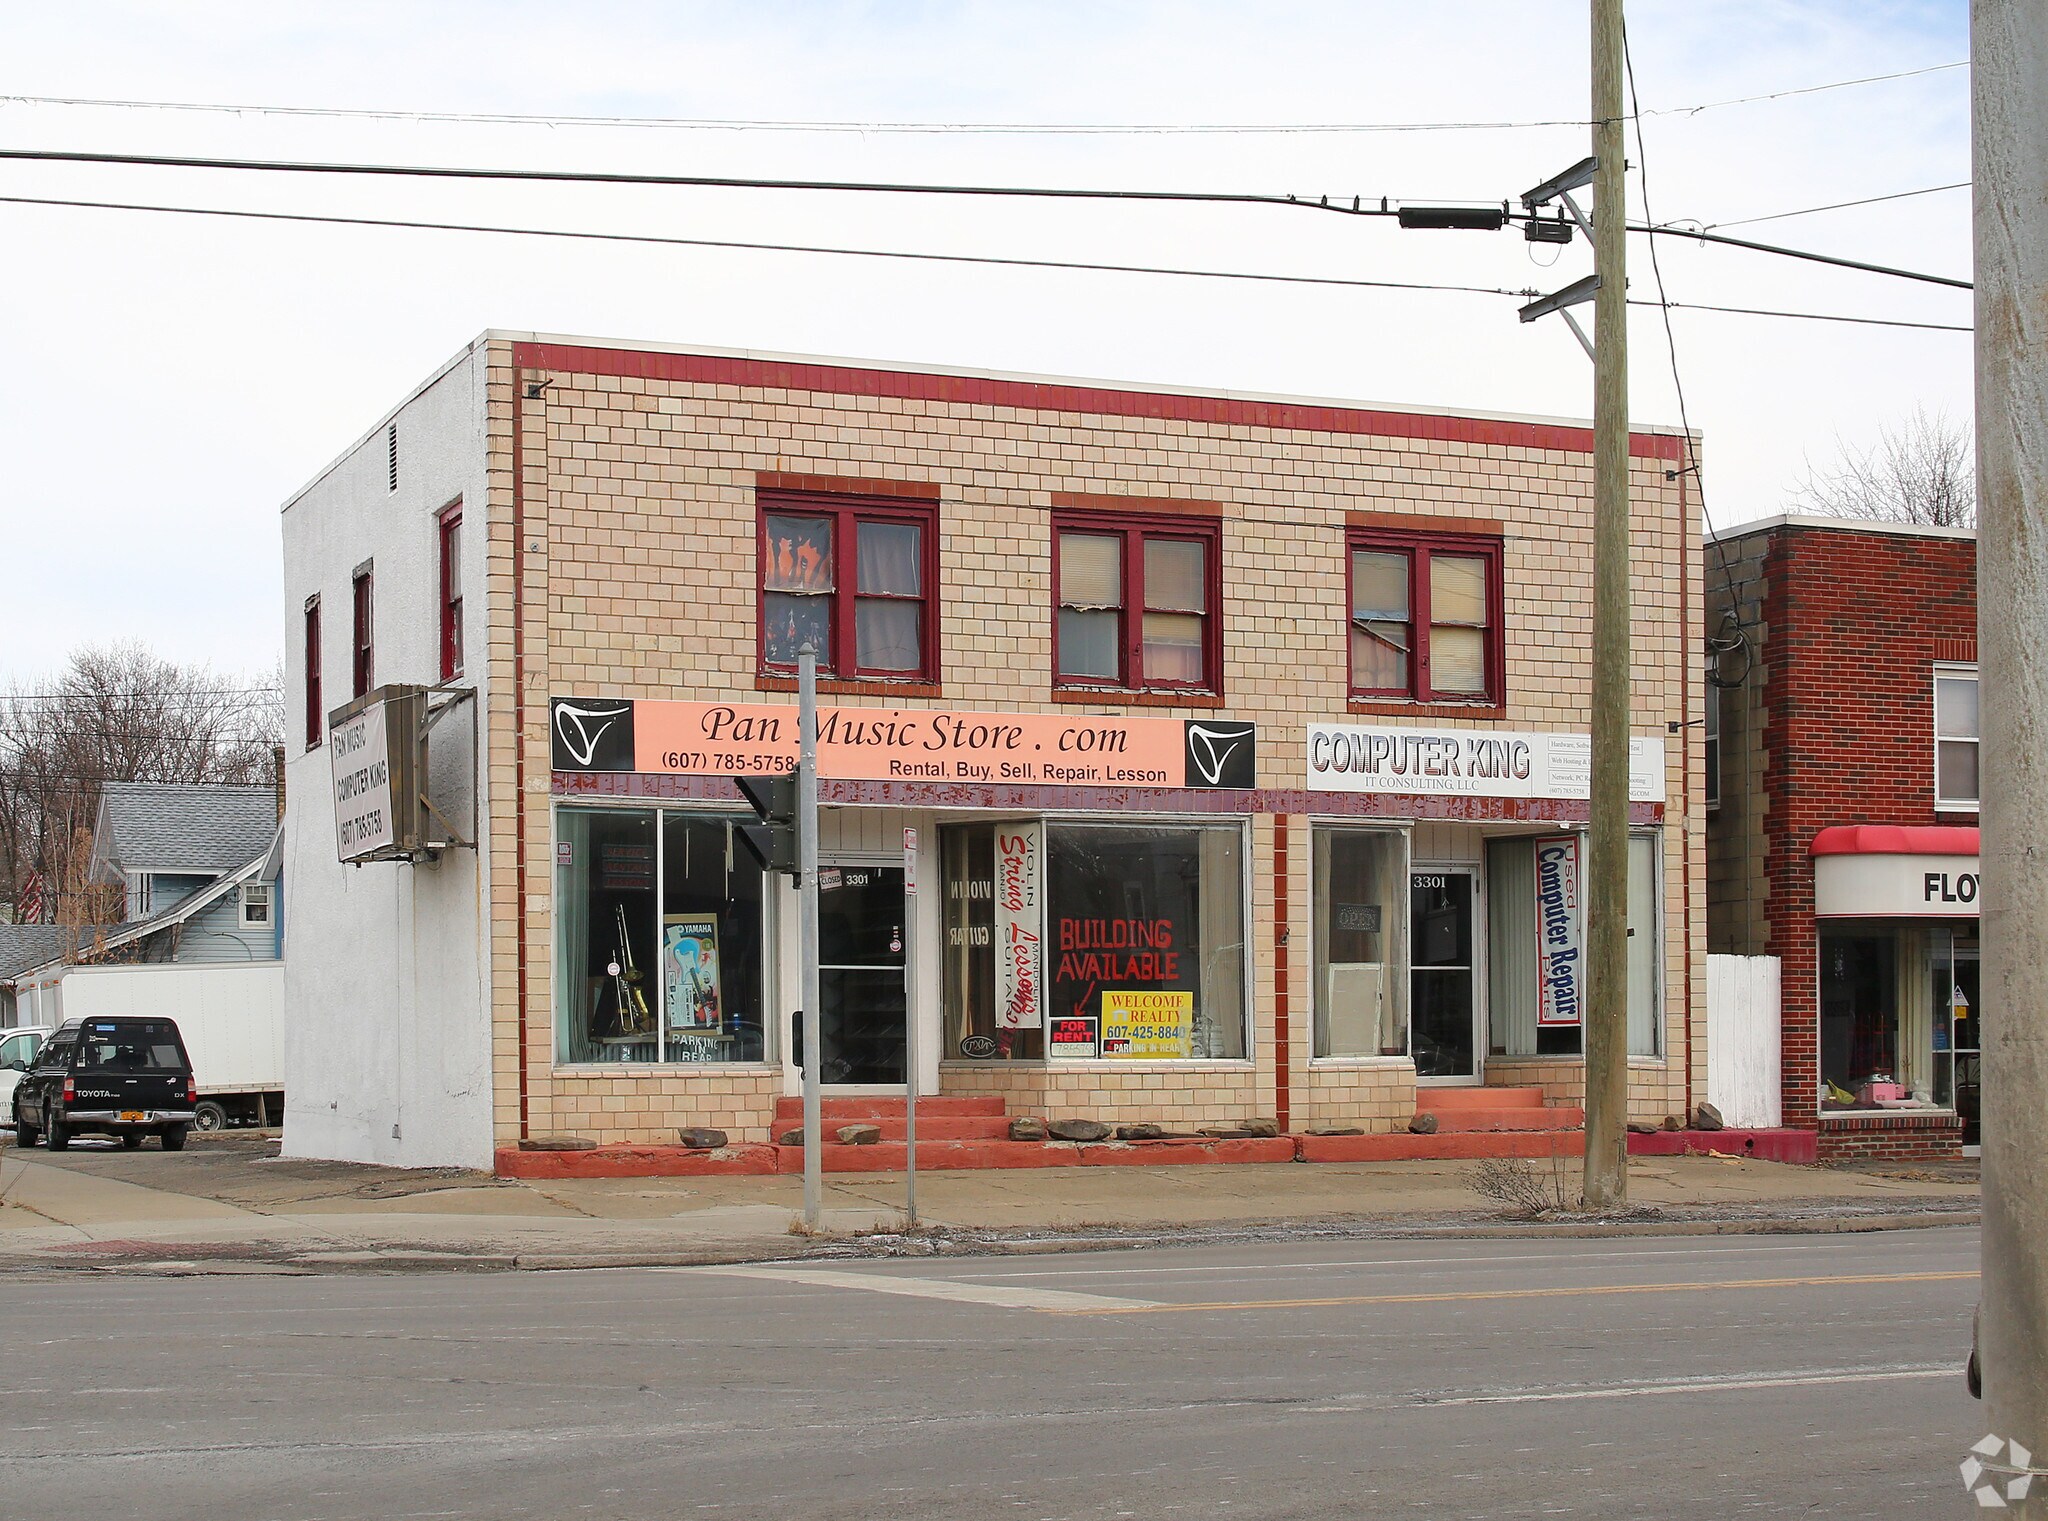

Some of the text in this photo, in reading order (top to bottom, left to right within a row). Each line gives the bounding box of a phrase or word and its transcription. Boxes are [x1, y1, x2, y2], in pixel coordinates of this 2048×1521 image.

[701, 707, 781, 742] Pan
[794, 710, 916, 747] Music
[923, 715, 1022, 750] Store
[1059, 728, 1128, 752] com
[334, 722, 367, 760] PAN MUSIC
[1551, 740, 1575, 749] Hardware,
[662, 751, 795, 772] (607) 785-5758
[1310, 731, 1530, 779] COMPUTER KING
[1563, 758, 1582, 766] Hosting
[889, 760, 1167, 783] Rental, Buy, Sell, Repair, Lesson
[1551, 773, 1575, 781] Network,
[337, 760, 387, 803] COMPUTER KING
[1365, 776, 1377, 787] IT
[1457, 779, 1479, 791] LLC
[341, 808, 382, 852] (607) 785-5758
[1026, 832, 1035, 907] VIOLIN
[1564, 845, 1576, 909] Used
[820, 875, 841, 885] CLOSED
[846, 874, 868, 885] 3301
[1413, 876, 1446, 888] 3301
[1924, 873, 1979, 903] FLO
[684, 925, 712, 933] YAMAHA
[1000, 834, 1039, 1016] String Lessons
[1060, 918, 1174, 950] BUILDING
[1536, 847, 1579, 1015] Computer Repair
[1004, 927, 1012, 1015] GUITAR
[1056, 952, 1181, 983] AVAILABLE
[1542, 956, 1551, 1019] Parts
[1111, 995, 1184, 1008] WELCOME
[1130, 1010, 1182, 1023] REALTY
[1060, 1021, 1087, 1031] FOR
[1107, 1025, 1186, 1039] 607-425-8840
[1053, 1032, 1093, 1042] RENT
[682, 1051, 712, 1062] REAR
[694, 1045, 706, 1054] IN
[1113, 1043, 1146, 1054] PARKING
